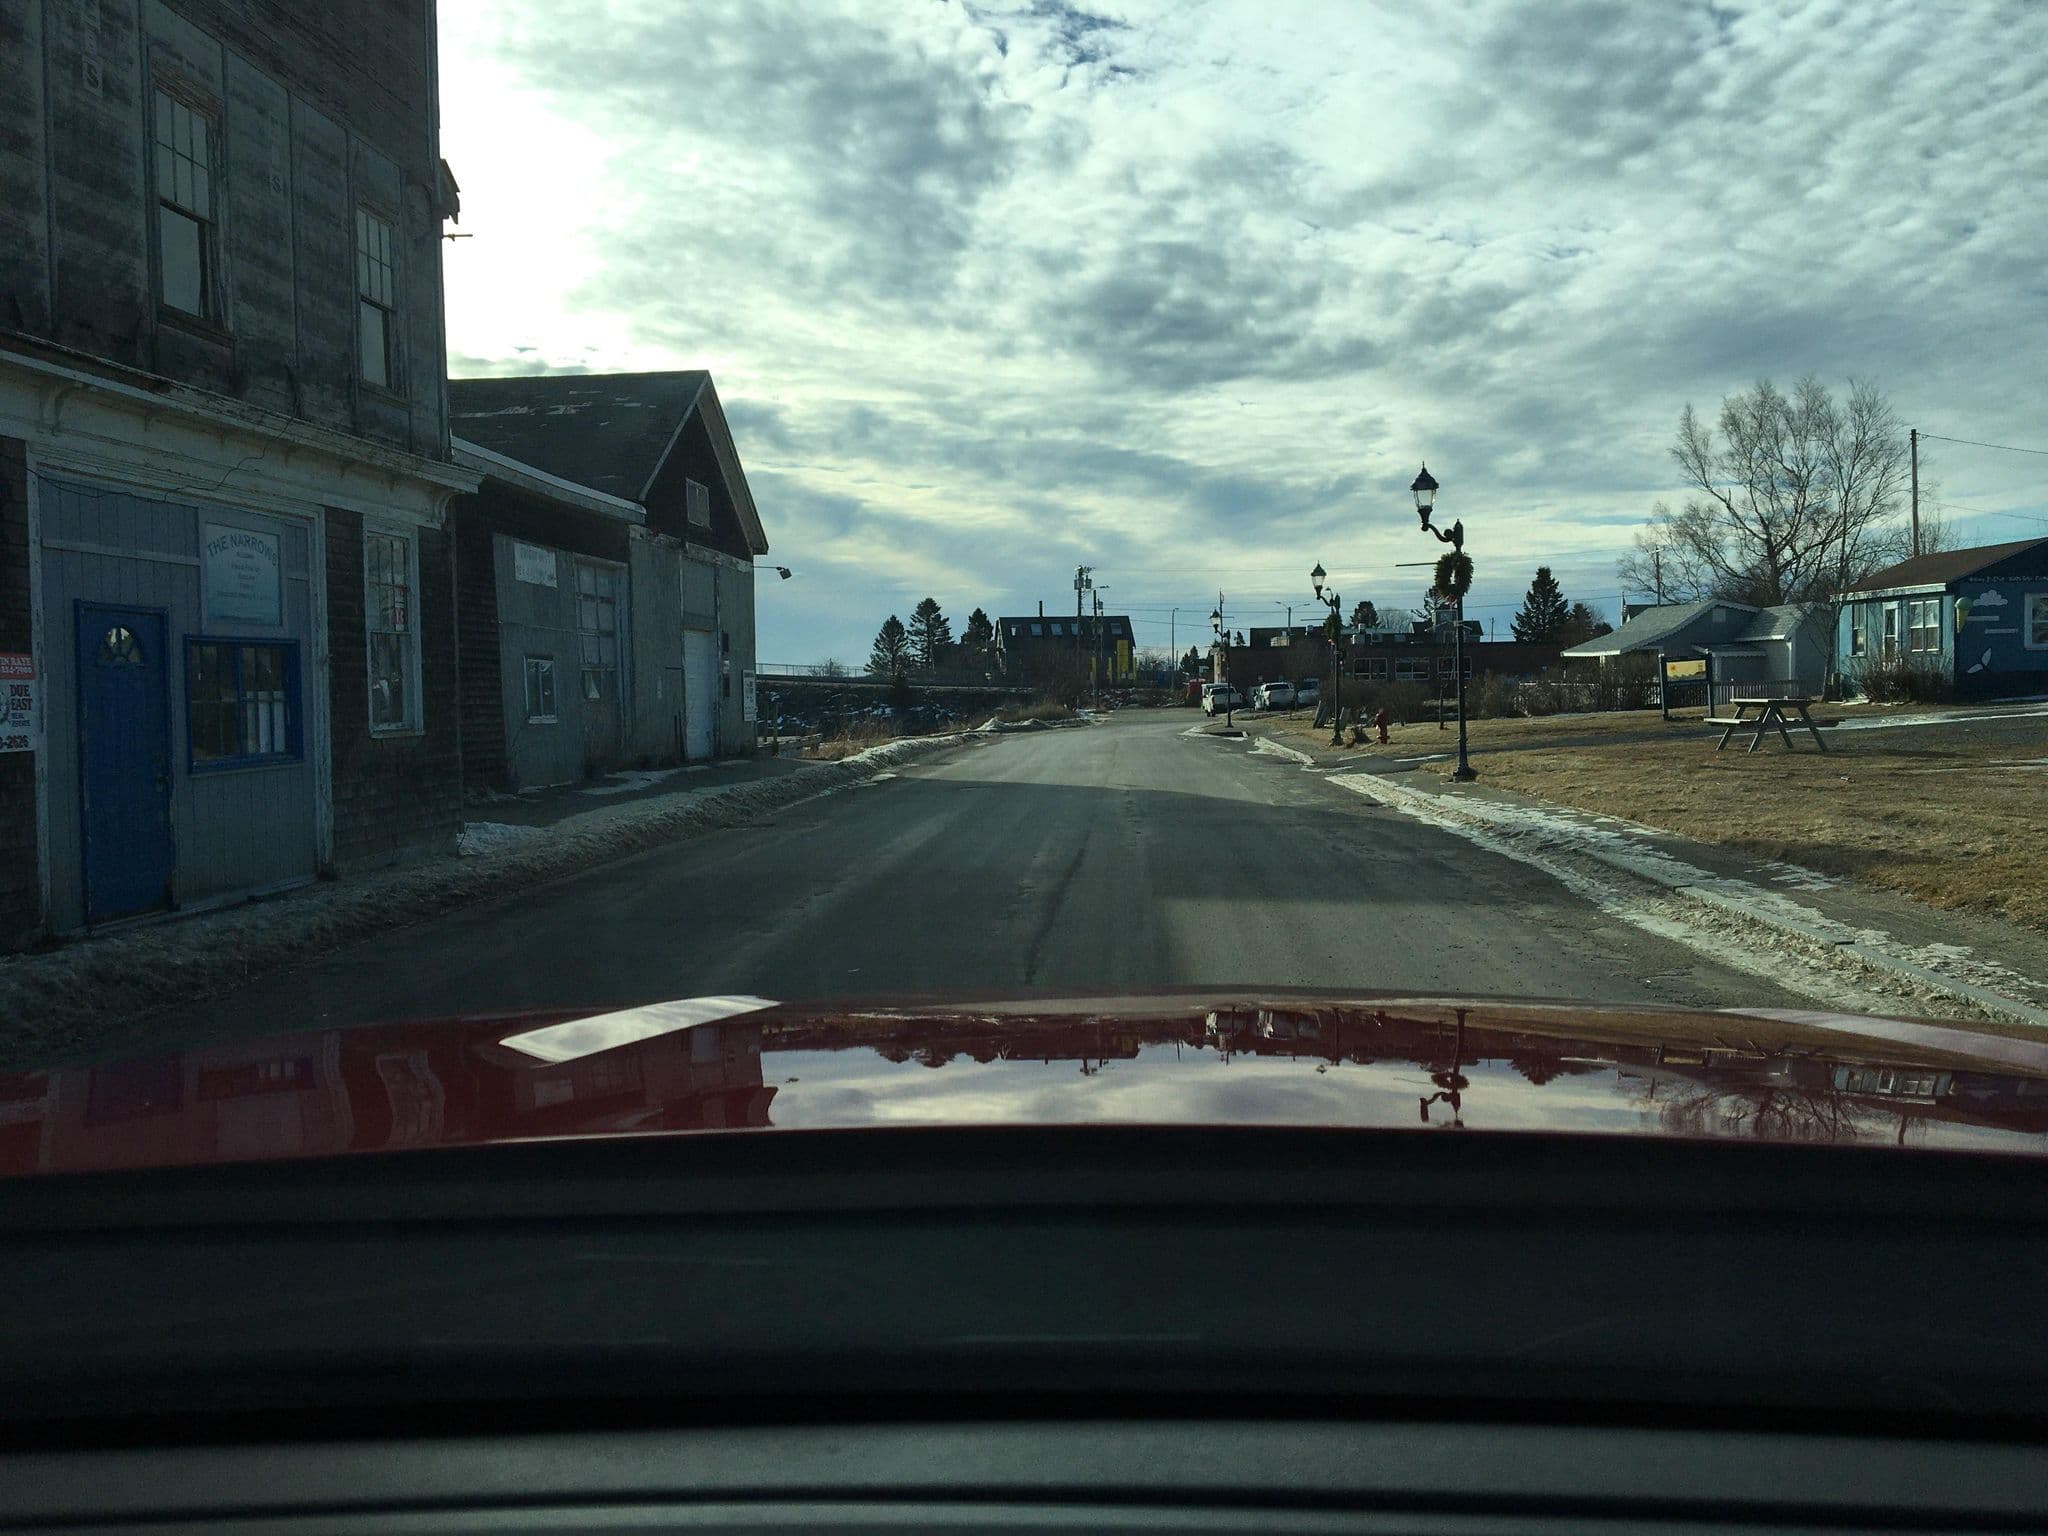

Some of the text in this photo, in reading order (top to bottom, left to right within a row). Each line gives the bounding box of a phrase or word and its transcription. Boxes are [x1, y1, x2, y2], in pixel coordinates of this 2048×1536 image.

[207, 533, 278, 567] THE NARROWS
[9, 684, 30, 697] DUE
[11, 698, 33, 711] EAST
